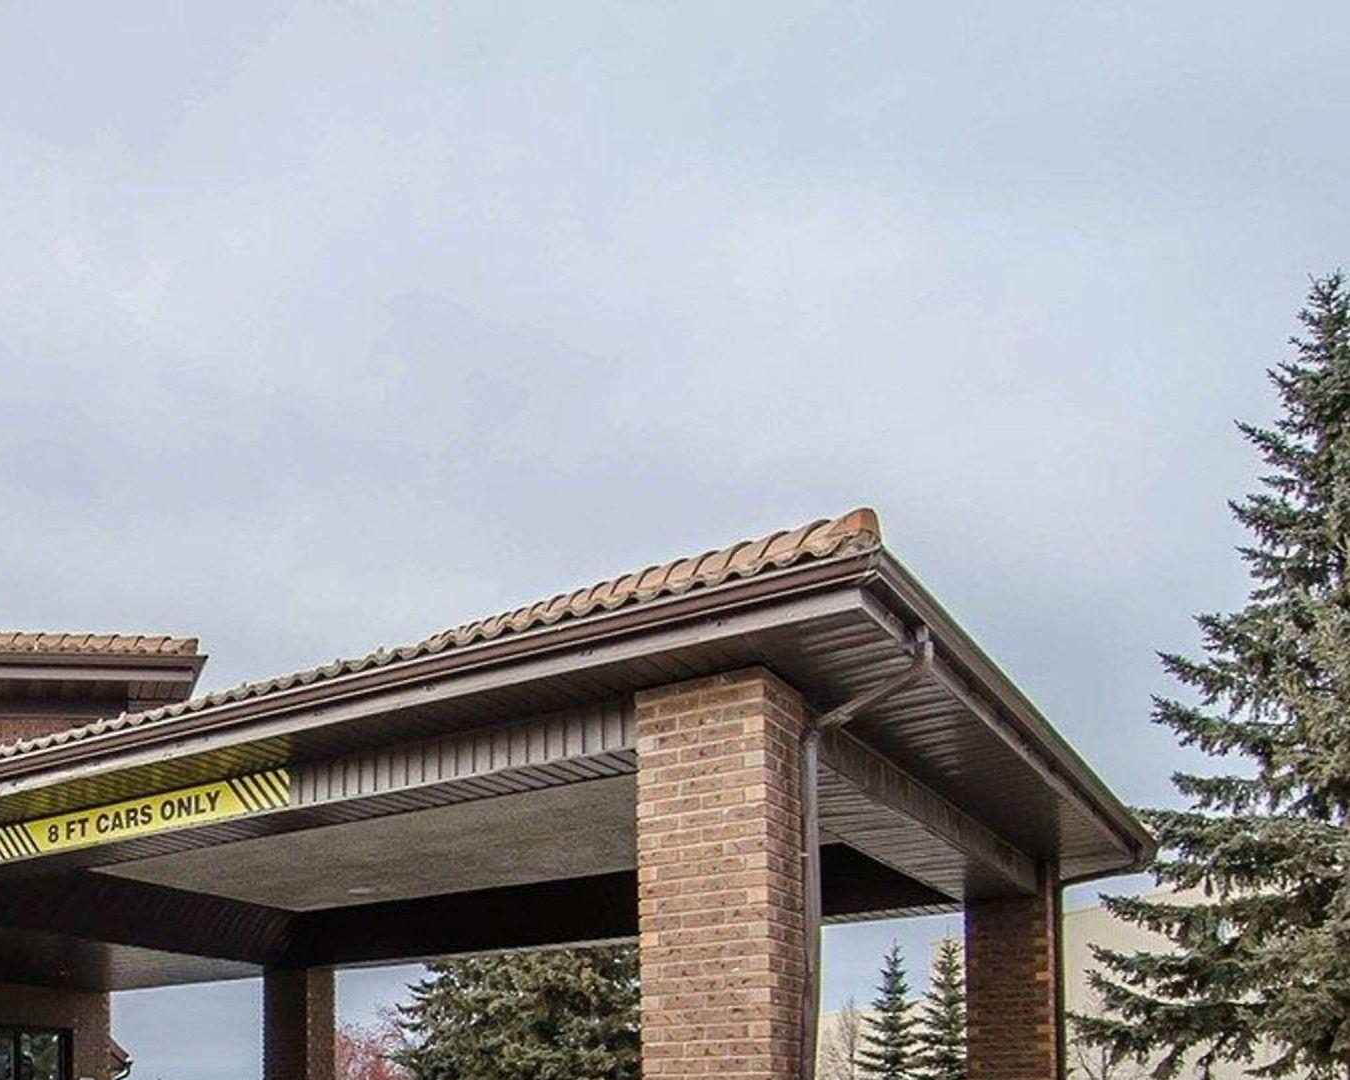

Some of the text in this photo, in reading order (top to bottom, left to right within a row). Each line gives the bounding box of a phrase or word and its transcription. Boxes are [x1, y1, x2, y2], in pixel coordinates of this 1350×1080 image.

[47, 790, 221, 843] 8 FT CARS ONLY
